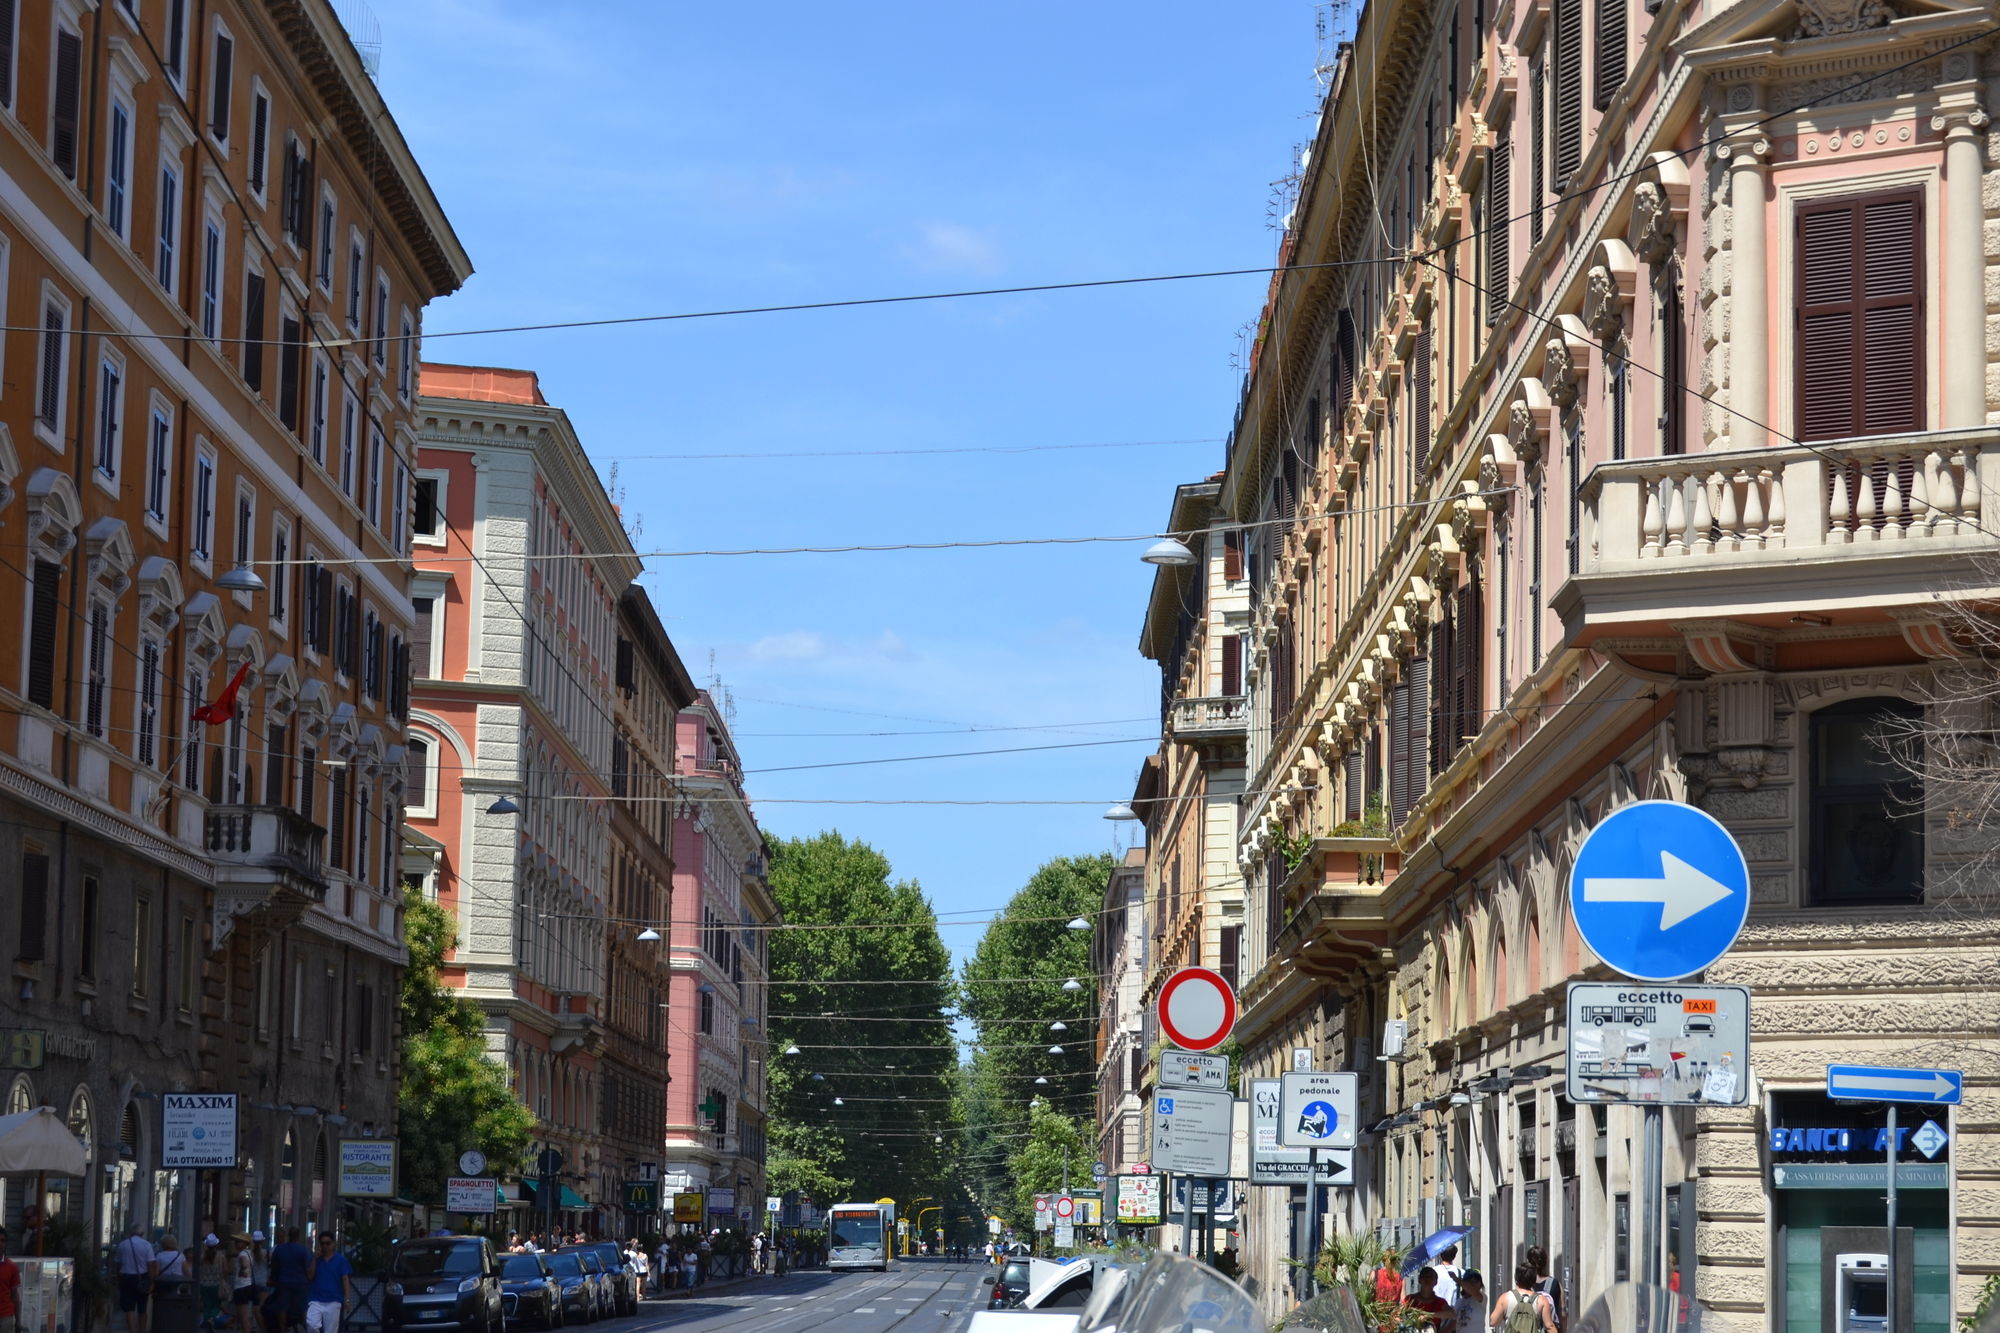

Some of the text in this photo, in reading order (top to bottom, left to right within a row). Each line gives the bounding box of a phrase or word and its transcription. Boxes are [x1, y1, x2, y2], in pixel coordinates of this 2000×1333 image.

[1618, 990, 1683, 1004] eccetto
[1687, 1001, 1712, 1011] TAXI
[1176, 1056, 1213, 1066] eccetto
[1206, 1070, 1221, 1079] AMA
[1299, 1087, 1341, 1096] pedonale
[167, 1096, 233, 1109] MAXIM
[167, 1156, 233, 1164] VIA OTTAVIANO 17
[343, 1153, 392, 1161] RISTORANTE
[1786, 1172, 1814, 1181] CASSA
[1825, 1172, 1874, 1181] RISPARMIO
[449, 1179, 494, 1188] SPAGNOLETTO
